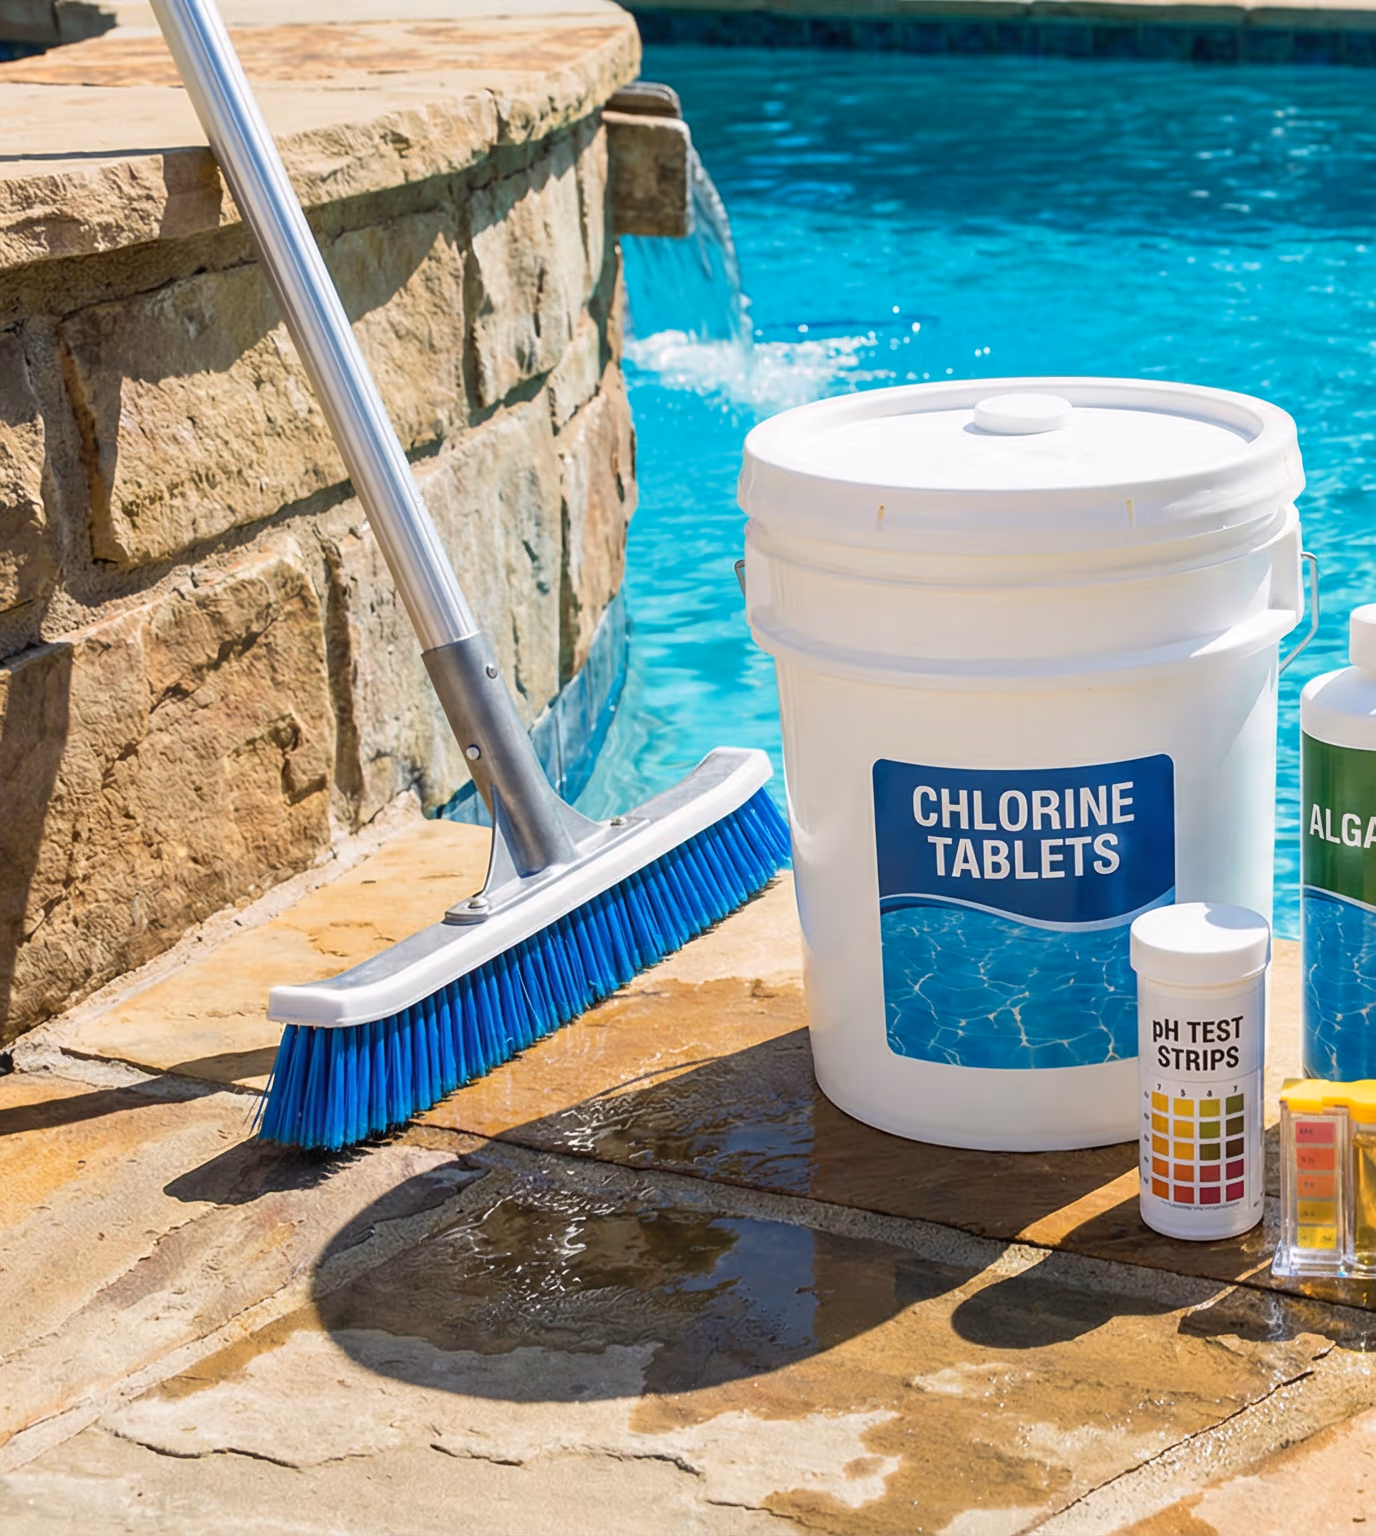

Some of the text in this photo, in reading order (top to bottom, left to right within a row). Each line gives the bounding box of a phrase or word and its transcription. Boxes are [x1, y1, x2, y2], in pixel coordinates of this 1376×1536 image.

[912, 781, 1135, 832] CHLORINE
[927, 833, 1120, 880] TABLETS
[1152, 1015, 1244, 1044] pH TEST
[1157, 1045, 1240, 1072] STRIPS
